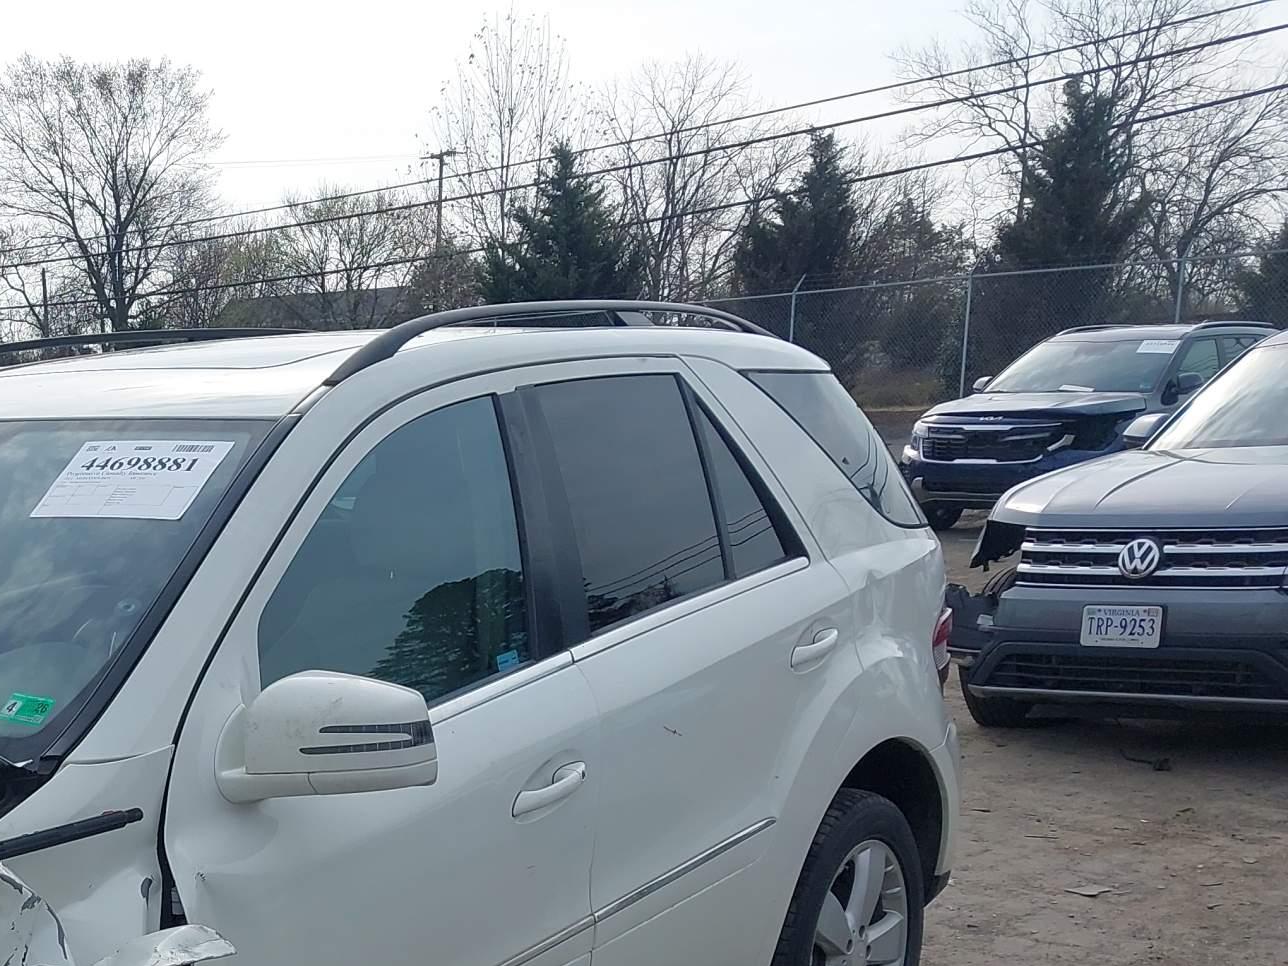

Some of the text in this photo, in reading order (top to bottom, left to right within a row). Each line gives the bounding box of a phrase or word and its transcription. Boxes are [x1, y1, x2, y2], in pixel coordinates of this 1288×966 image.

[81, 456, 200, 472] 44698881
[1103, 608, 1140, 617] VIRGINIA
[1087, 616, 1156, 637] TRP-9253
